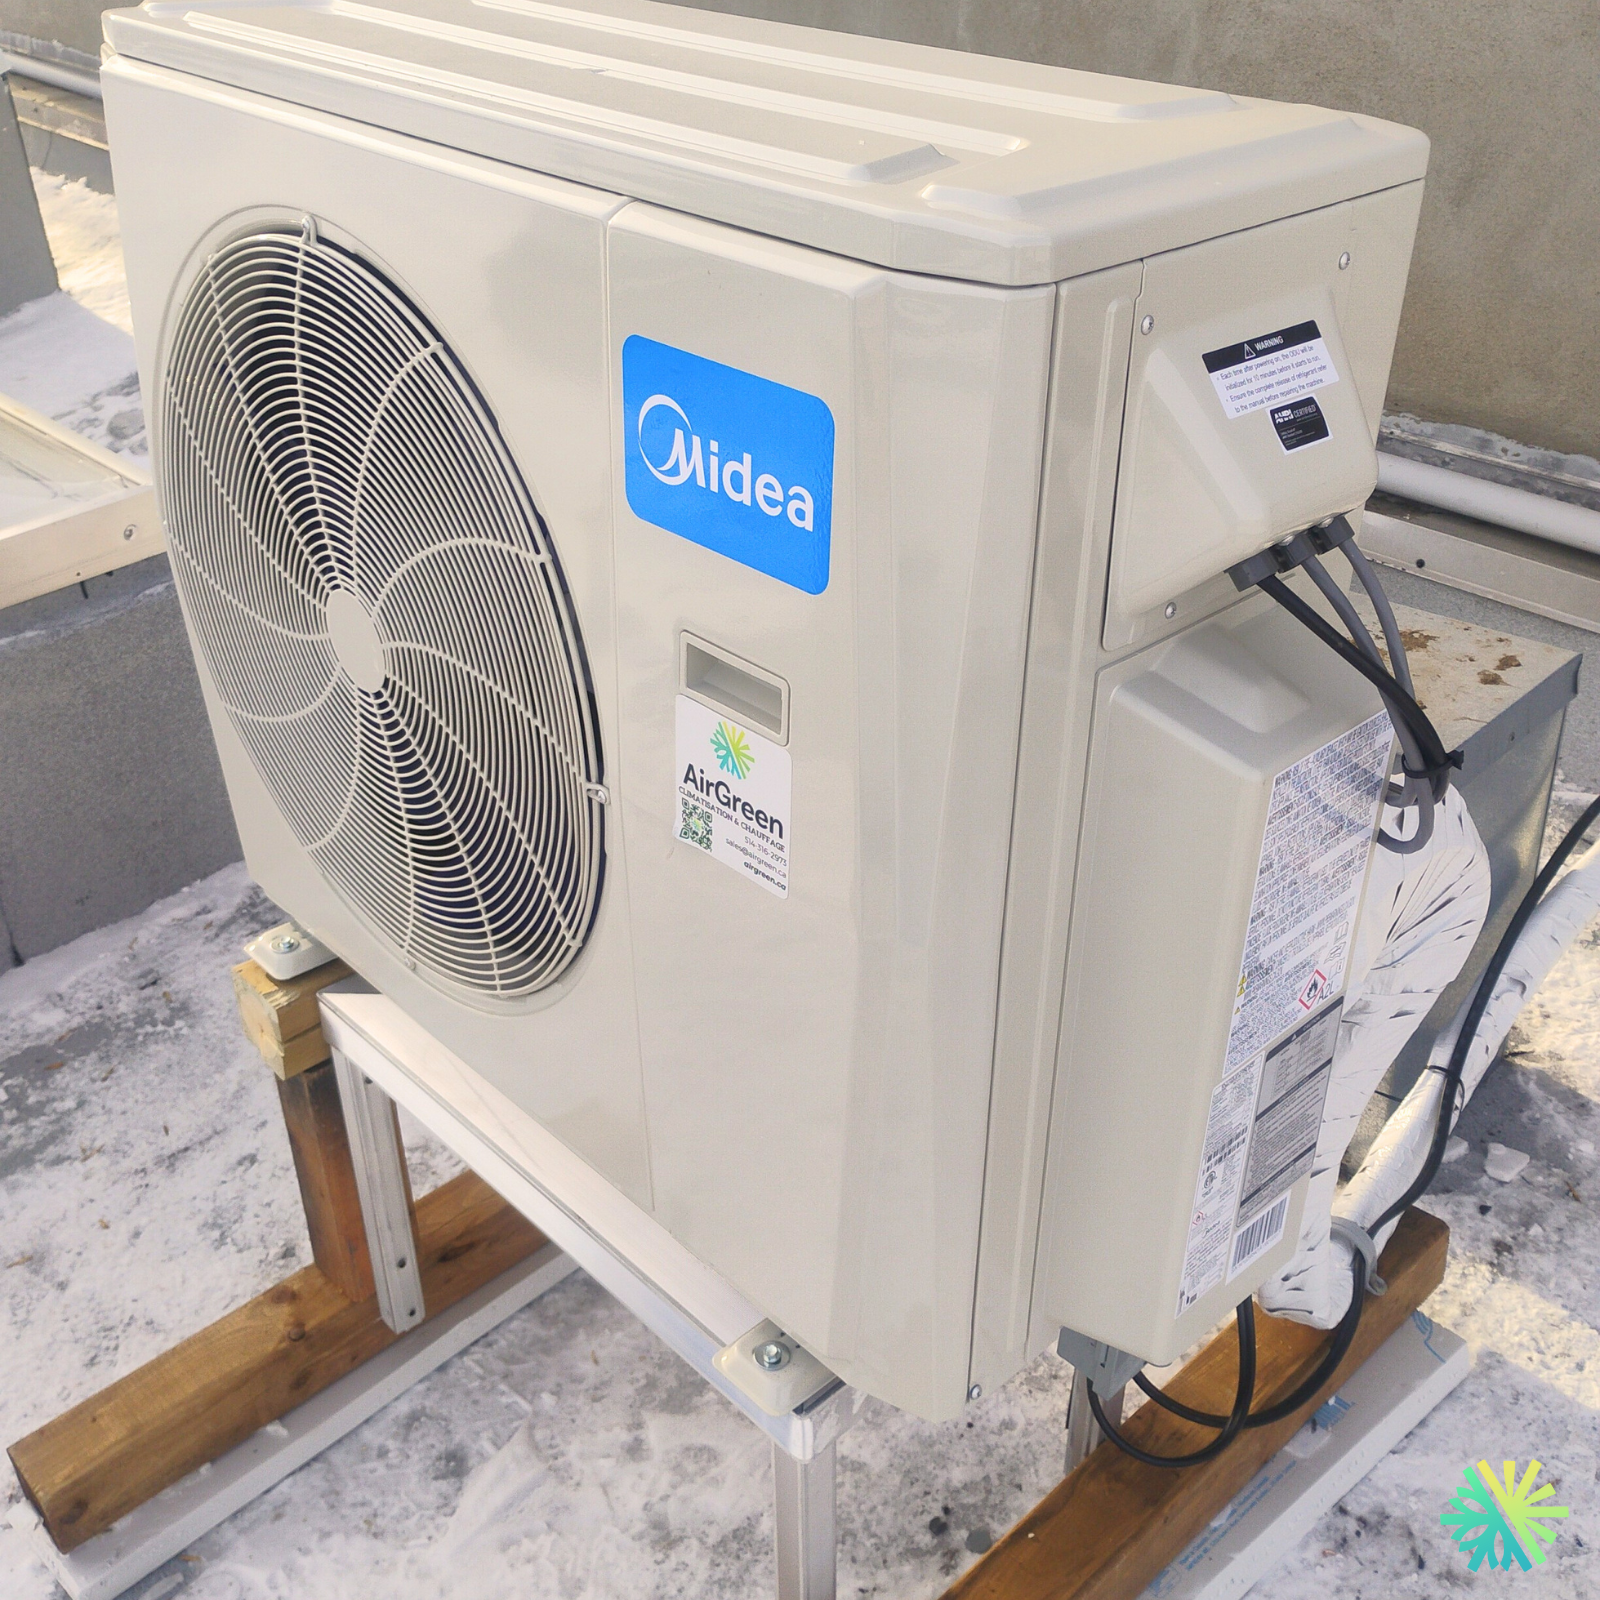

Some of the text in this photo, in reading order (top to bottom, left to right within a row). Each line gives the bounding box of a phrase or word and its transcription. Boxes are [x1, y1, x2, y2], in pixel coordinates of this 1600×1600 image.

[1254, 335, 1284, 351] WARNING
[1220, 371, 1233, 380] Each
[1243, 364, 1254, 372] after
[1254, 359, 1274, 370] powering
[1225, 379, 1246, 391] initialized
[1259, 370, 1277, 379] minutes
[1277, 364, 1291, 373] before
[1294, 359, 1307, 367] starts
[1230, 392, 1247, 402] Ensure
[1254, 382, 1275, 395] complete
[1274, 377, 1290, 386] release
[1295, 368, 1317, 380] refrigerant
[1248, 399, 1265, 408] manual
[1264, 393, 1279, 402] before
[1279, 386, 1299, 399] repairing
[653, 420, 813, 532] Midea
[683, 763, 784, 840] AirGreen
[679, 786, 785, 853] CLIMATISATION & CHAUFFAGE
[725, 837, 787, 879] sales@airgreen.ca
[744, 836, 787, 867] 514-316-2973
[744, 861, 786, 891] airgreen.ca
[1317, 981, 1334, 1003] A2L
